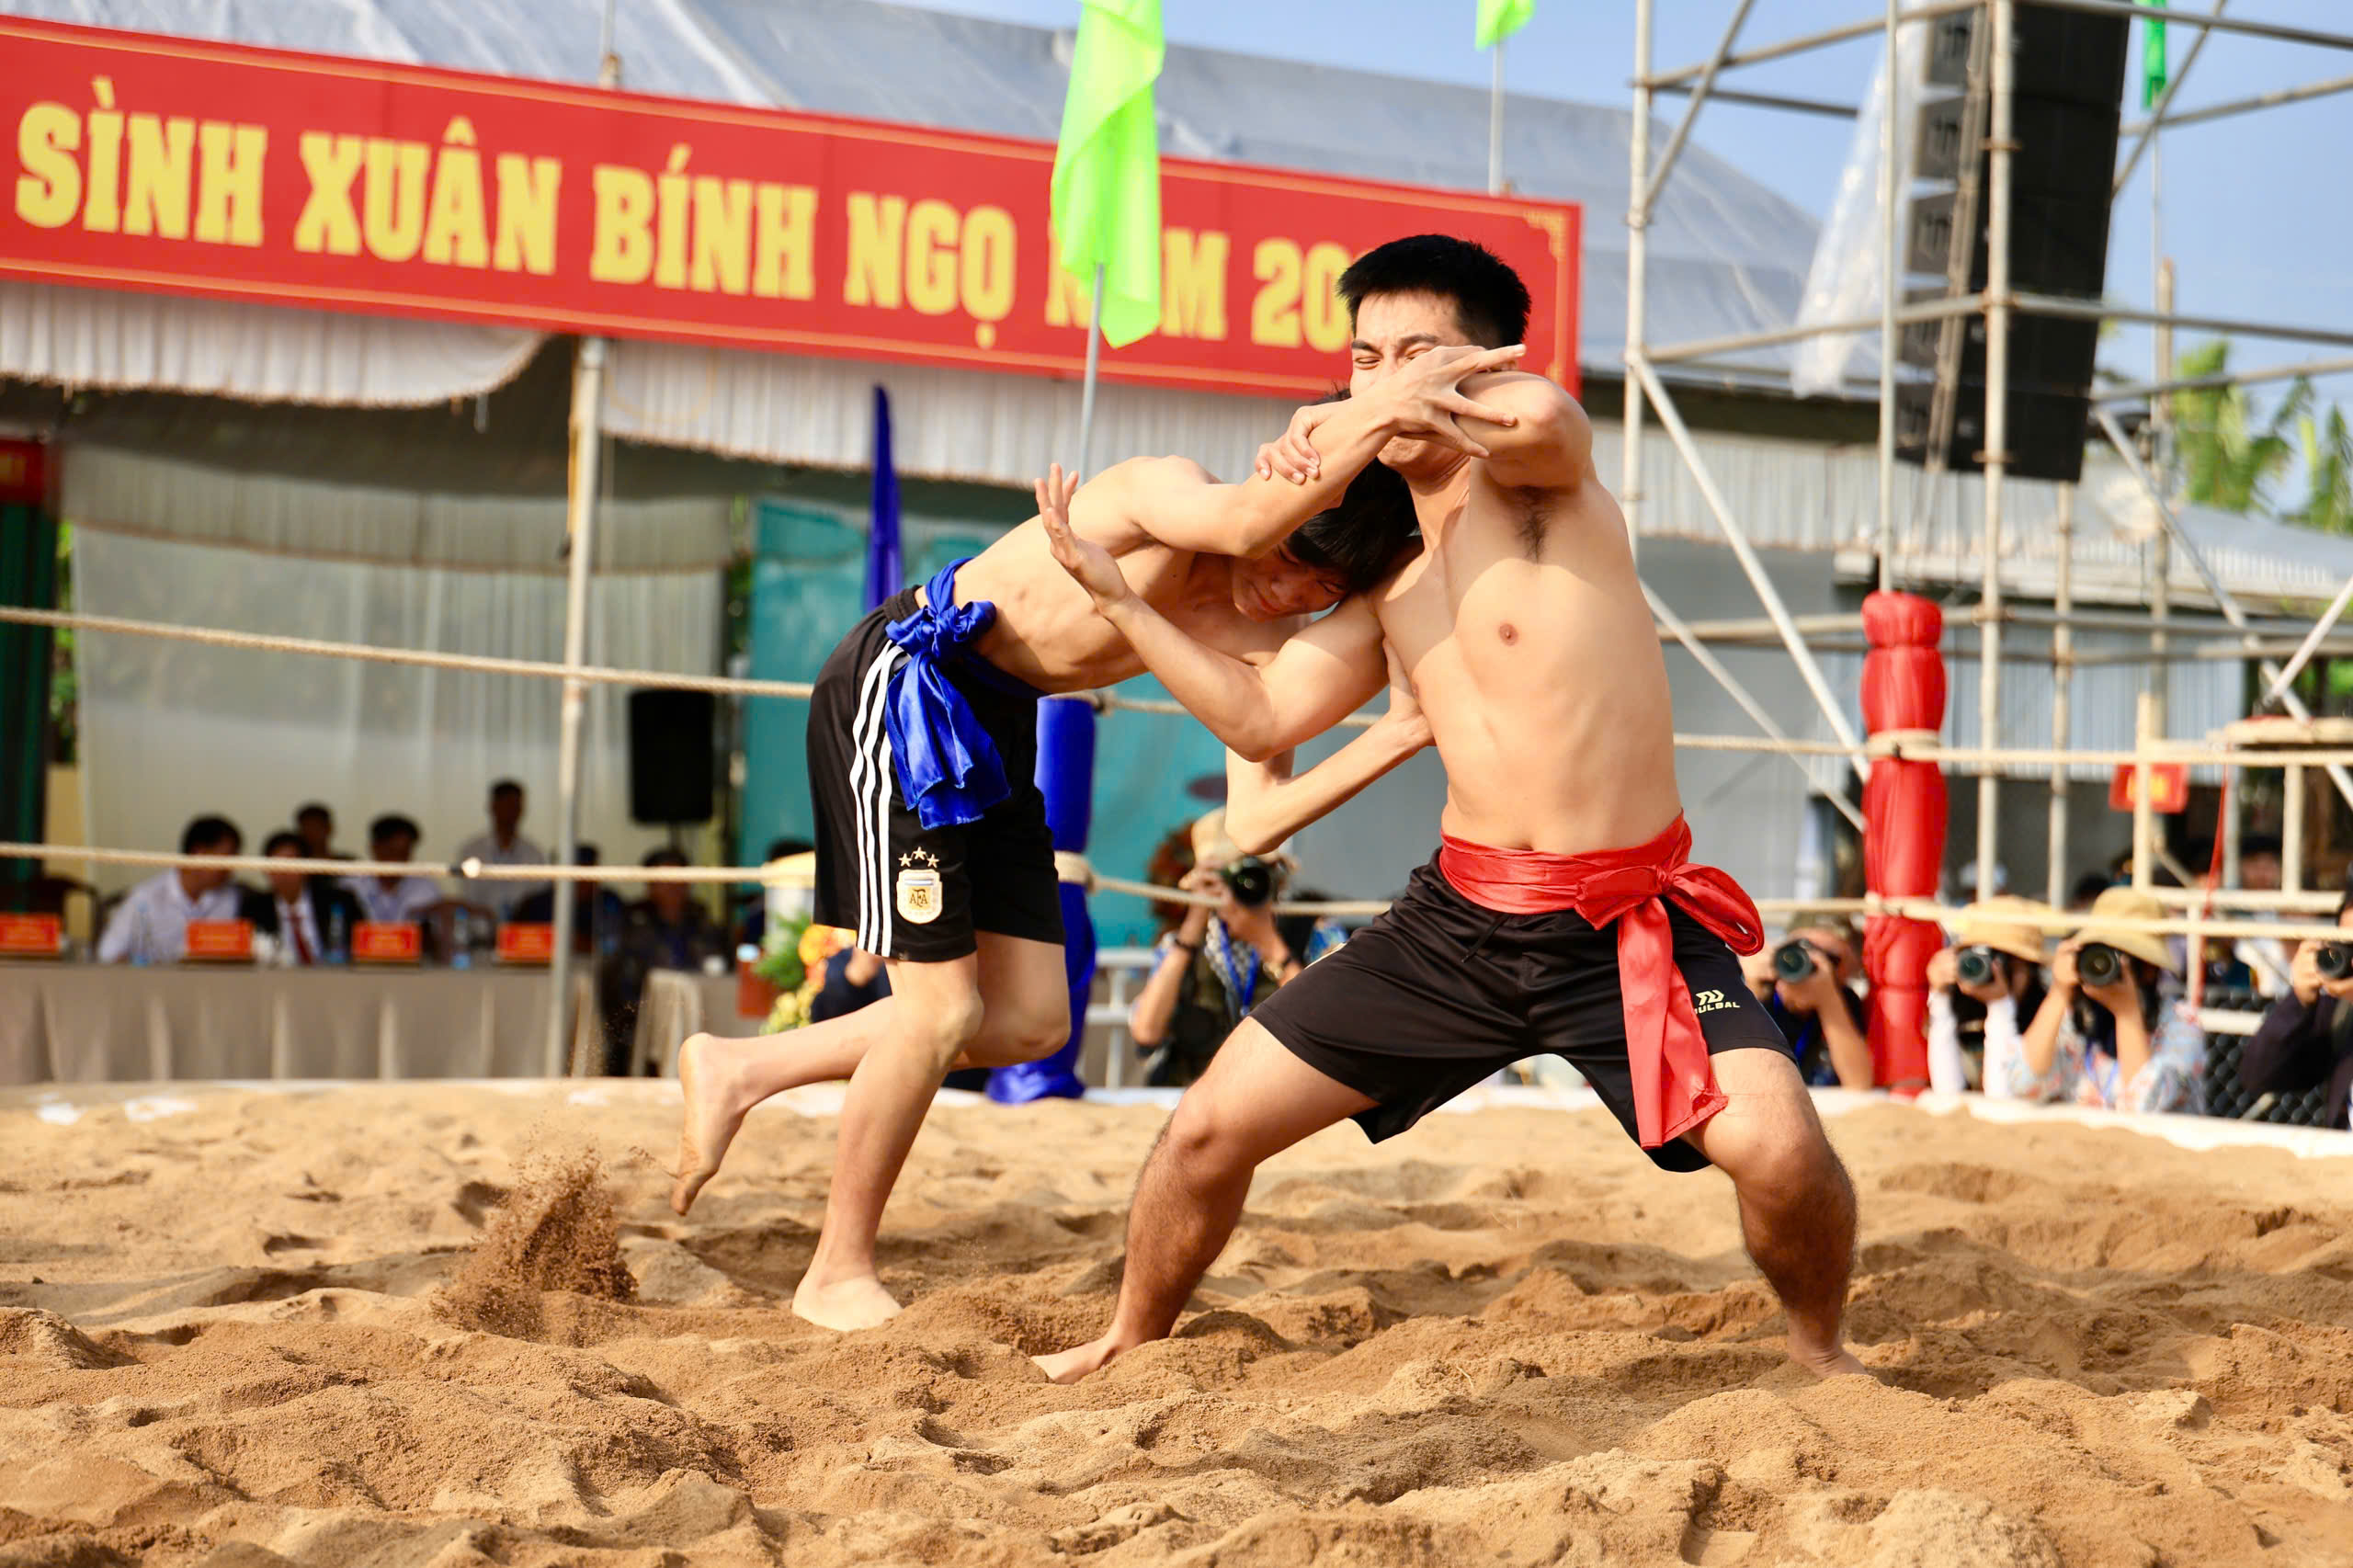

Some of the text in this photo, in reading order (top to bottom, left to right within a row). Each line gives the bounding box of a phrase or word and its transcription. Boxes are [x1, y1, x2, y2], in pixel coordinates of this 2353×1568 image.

[16, 75, 1360, 353] SÌNH XUÂN BÍNH NGỌ NM 20
